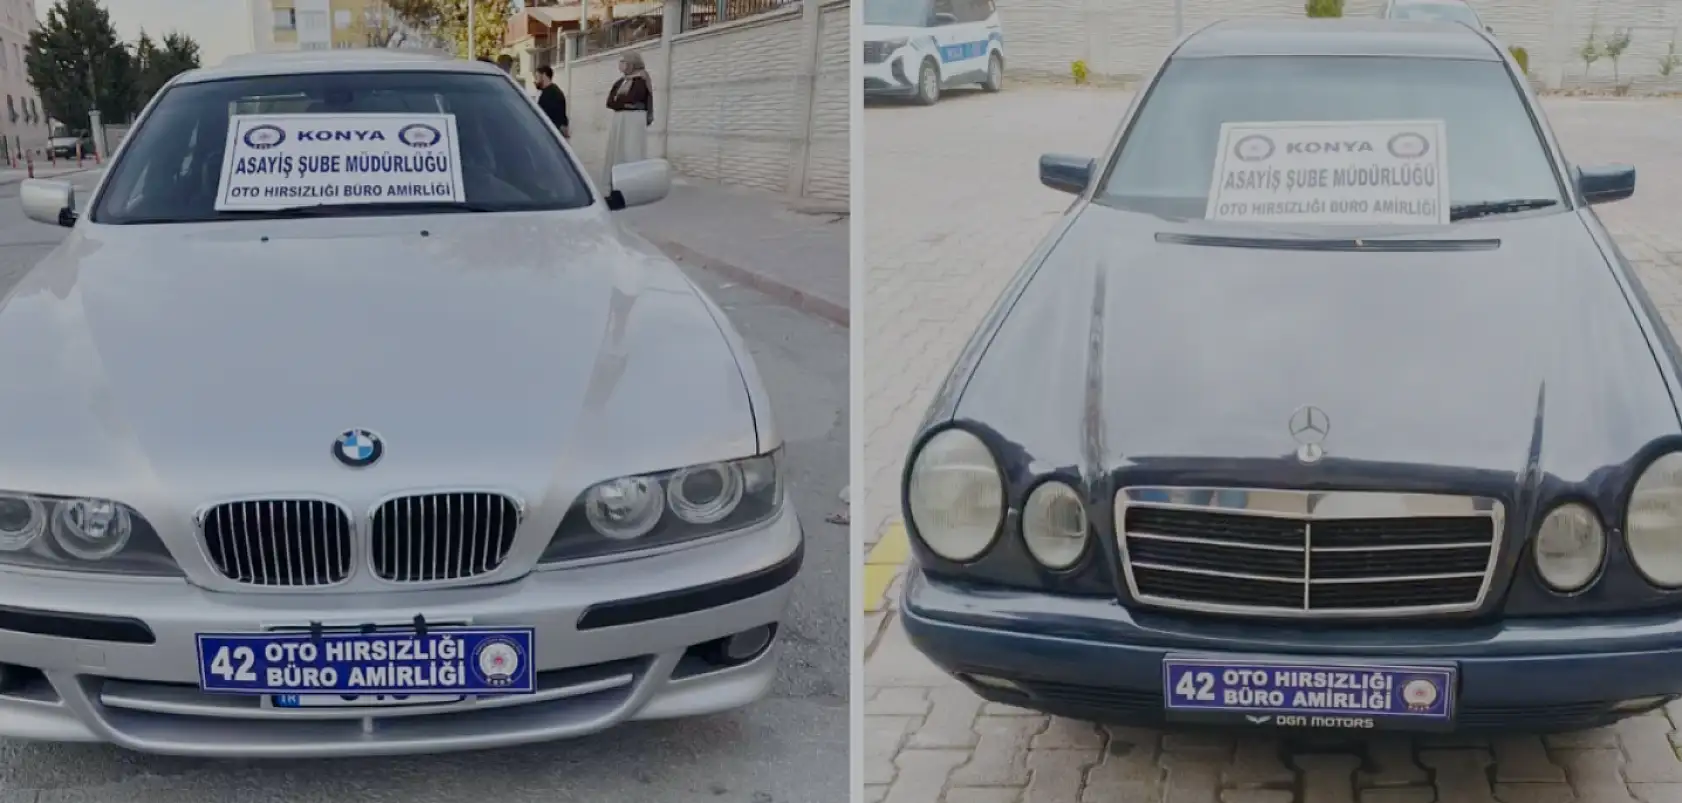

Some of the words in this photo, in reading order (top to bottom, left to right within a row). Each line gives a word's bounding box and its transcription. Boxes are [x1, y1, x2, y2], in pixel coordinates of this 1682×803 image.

[297, 130, 385, 142] KONYA
[1286, 141, 1373, 154] KONYA
[235, 152, 293, 178] ASAYİŞ
[298, 155, 340, 178] ŞUBE
[345, 151, 447, 174] MÜDÜRLÜĞÜ
[231, 186, 260, 198] OTO
[264, 184, 339, 198] HIRSIZLIĞI
[343, 184, 383, 197] BÜRO
[387, 181, 450, 197] AMİRLİĞİ
[1224, 165, 1281, 193] ASAYİŞ
[1286, 168, 1328, 193] ŞUBE
[1333, 163, 1435, 187] MÜDÜRLÜĞÜ
[1219, 203, 1247, 216] OTO
[1252, 199, 1325, 216] HIRSIZLIĞI
[1330, 199, 1368, 214] BÜRO
[1373, 196, 1437, 216] AMİRLİĞİ
[265, 642, 317, 662] OTO
[326, 636, 465, 662] HIRSIZLIĞI
[211, 646, 257, 682] 42
[266, 661, 338, 687] BÜRO
[348, 659, 466, 687] AMİRLİĞİ
[1175, 671, 1215, 701] 42
[1223, 669, 1268, 686] OTO
[1275, 671, 1393, 691] HIRSIZLIĞI
[1224, 687, 1284, 706] BÜRO
[1292, 687, 1392, 710] AMİRLİĞİ
[1311, 715, 1374, 729] MOTORS
